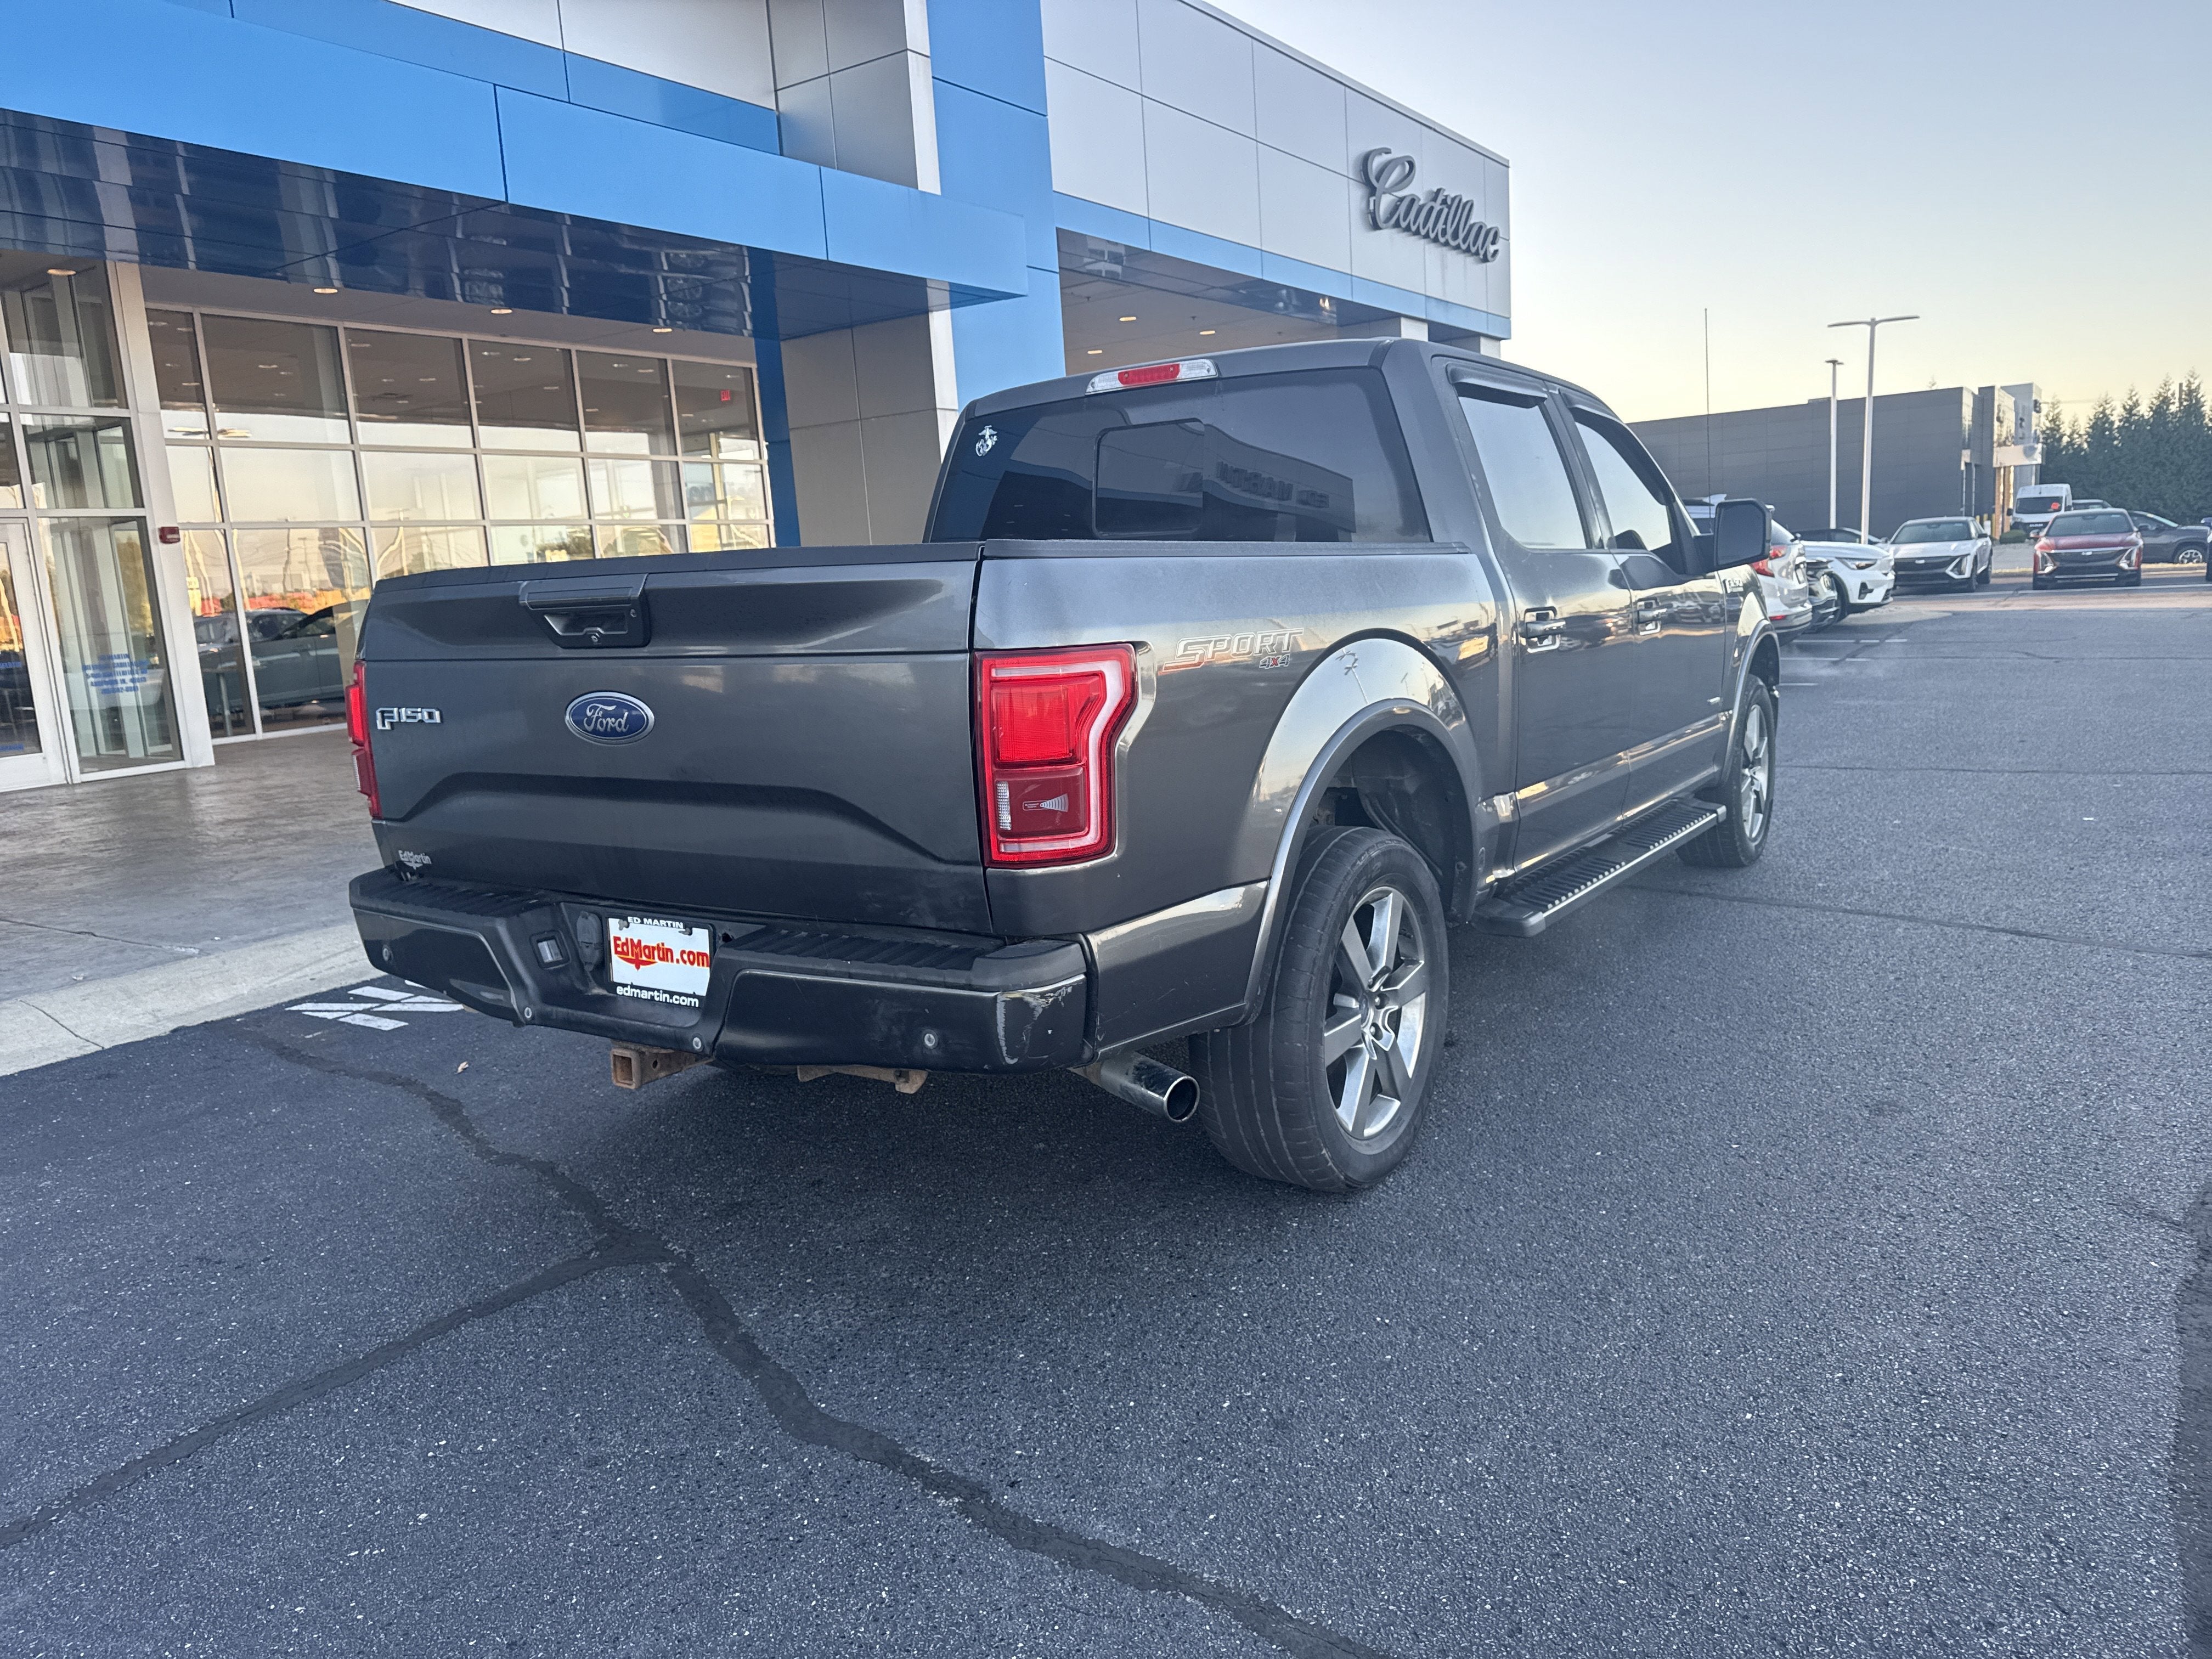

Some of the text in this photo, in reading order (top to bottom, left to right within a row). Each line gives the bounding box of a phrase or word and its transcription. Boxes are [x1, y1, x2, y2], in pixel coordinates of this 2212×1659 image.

[1362, 147, 1500, 262] Cadillac
[1163, 627, 1304, 672] SPORT
[583, 703, 629, 732] Ford
[643, 918, 684, 929] MARTIN
[616, 985, 699, 1007] edmartin.com
